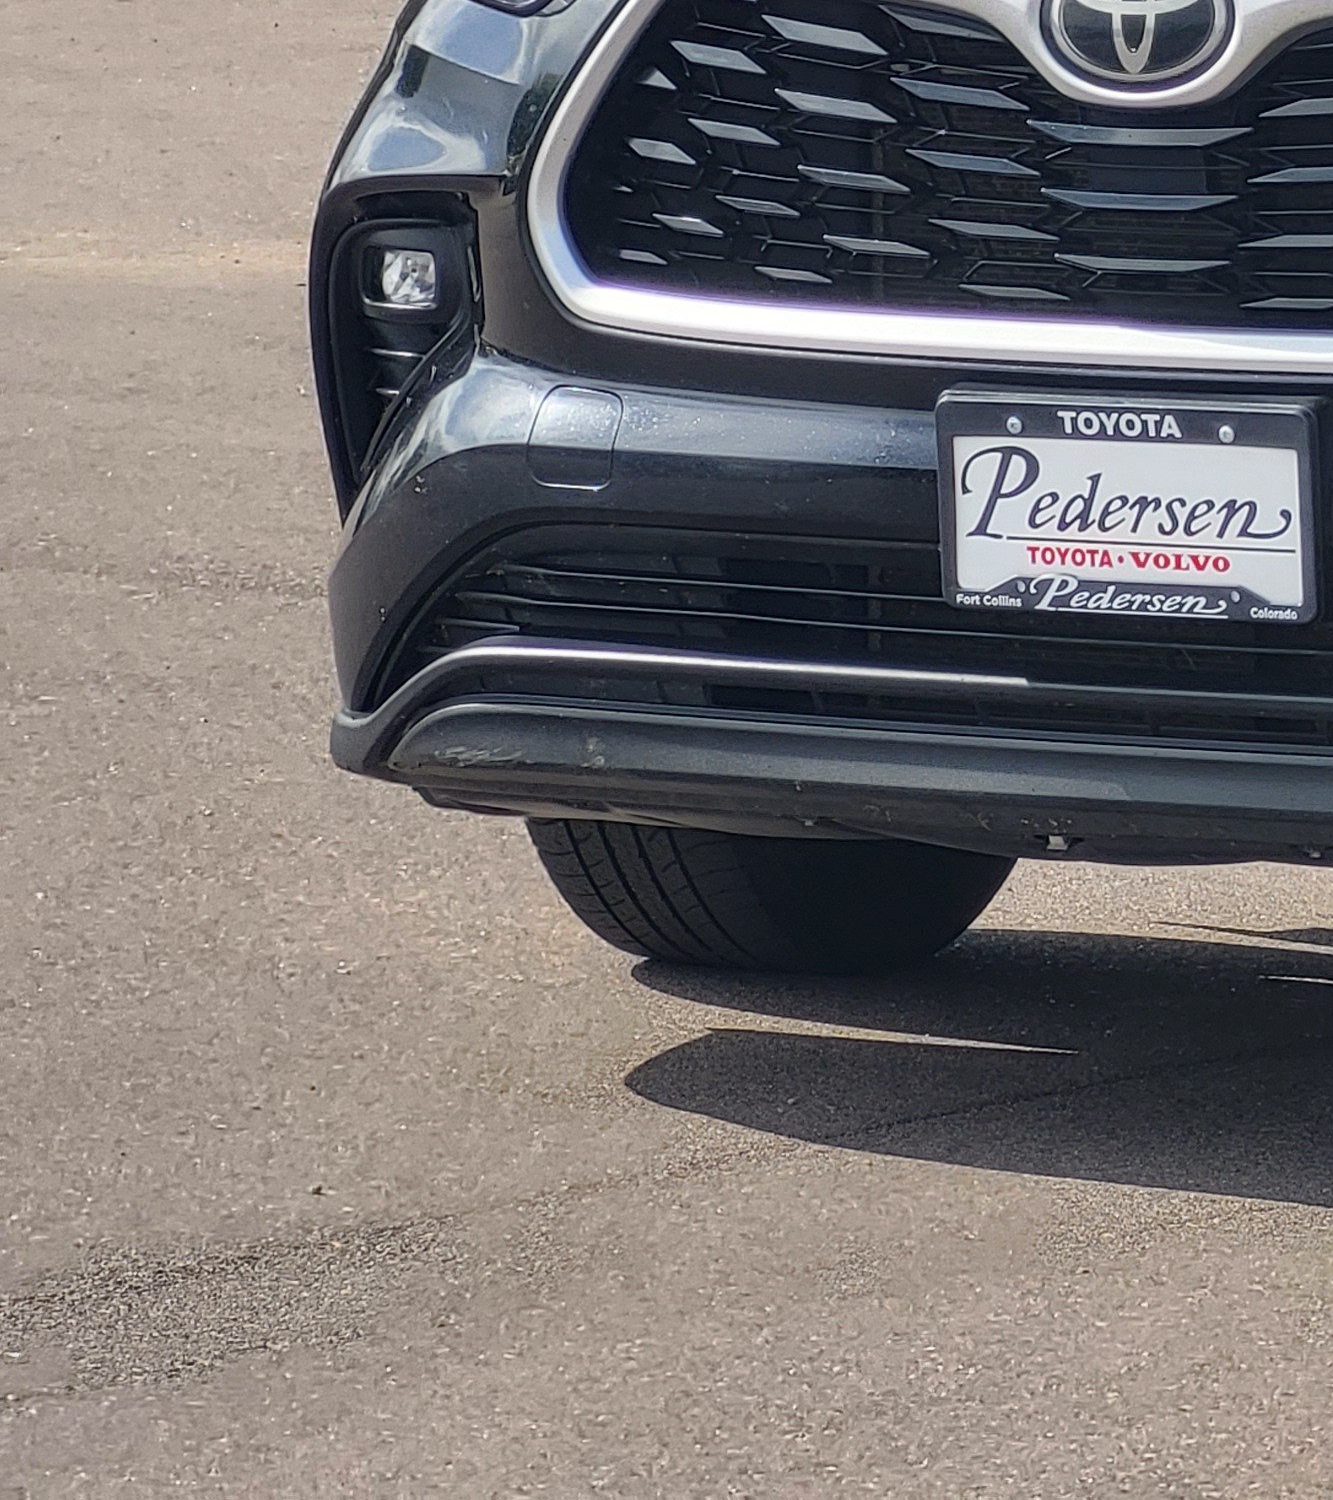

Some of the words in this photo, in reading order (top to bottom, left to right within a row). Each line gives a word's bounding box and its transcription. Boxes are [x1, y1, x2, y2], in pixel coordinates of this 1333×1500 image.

[1056, 410, 1182, 439] TOYOTA
[961, 445, 1293, 540] Pedersen
[1026, 546, 1113, 568] TOYOTA
[1128, 551, 1231, 573] VOLVO
[956, 593, 981, 606] Fort
[983, 594, 1022, 608] Collins
[1029, 573, 1228, 614] Pedersen
[1249, 606, 1298, 621] Colorado
